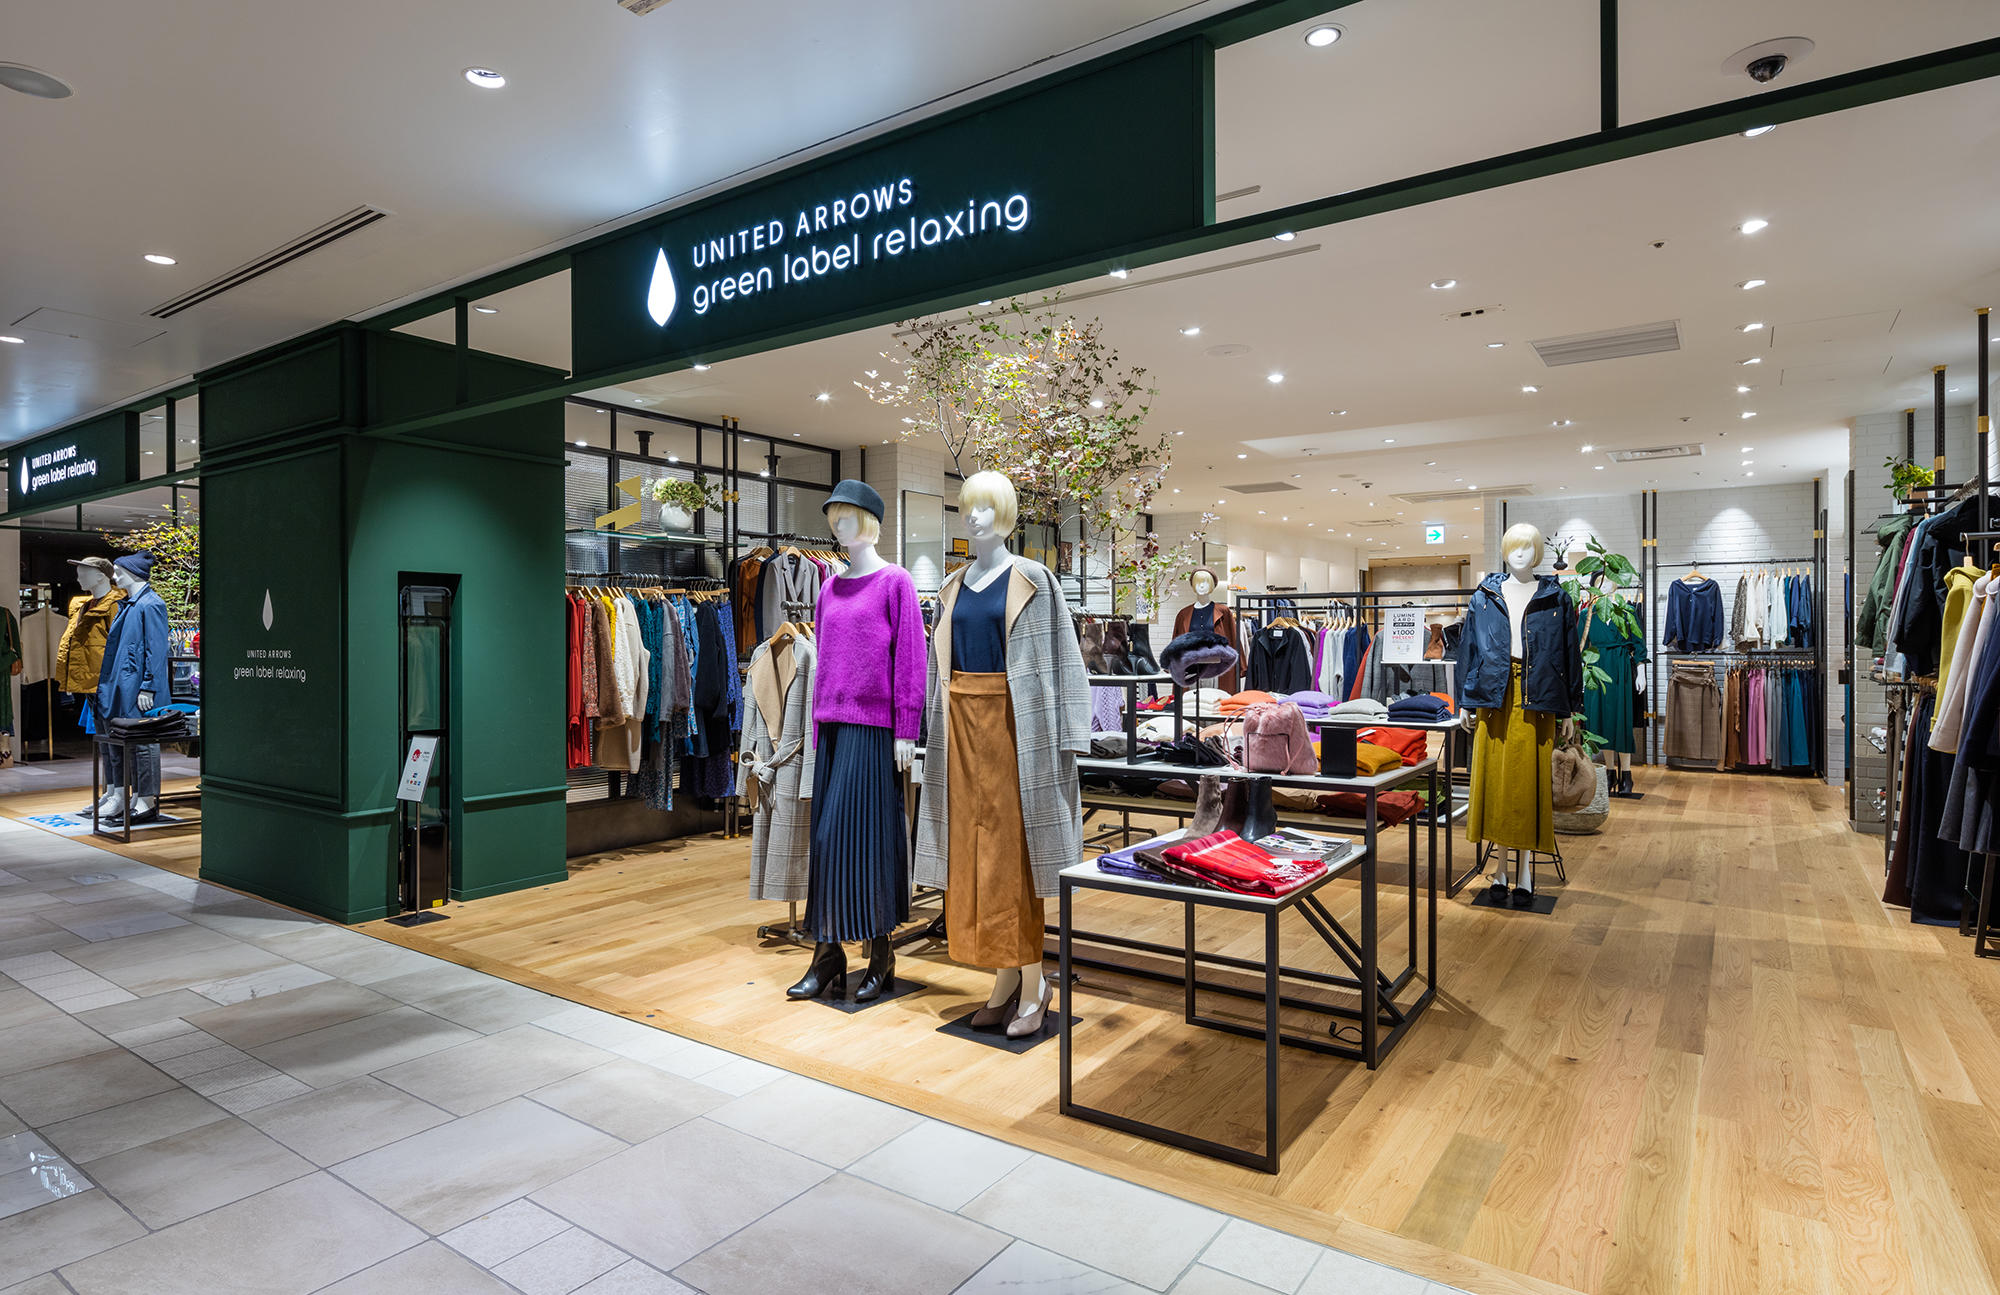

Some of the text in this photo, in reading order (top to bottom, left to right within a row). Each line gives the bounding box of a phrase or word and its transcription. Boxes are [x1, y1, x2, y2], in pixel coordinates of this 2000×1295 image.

[693, 178, 913, 268] UNITED ARROWS
[692, 193, 1030, 315] green label relaxing
[31, 445, 77, 469] UNITED ARROWS
[31, 458, 97, 491] green label relaxing
[246, 650, 292, 658] UNITED ARROWS
[233, 664, 307, 683] green label relaxing
